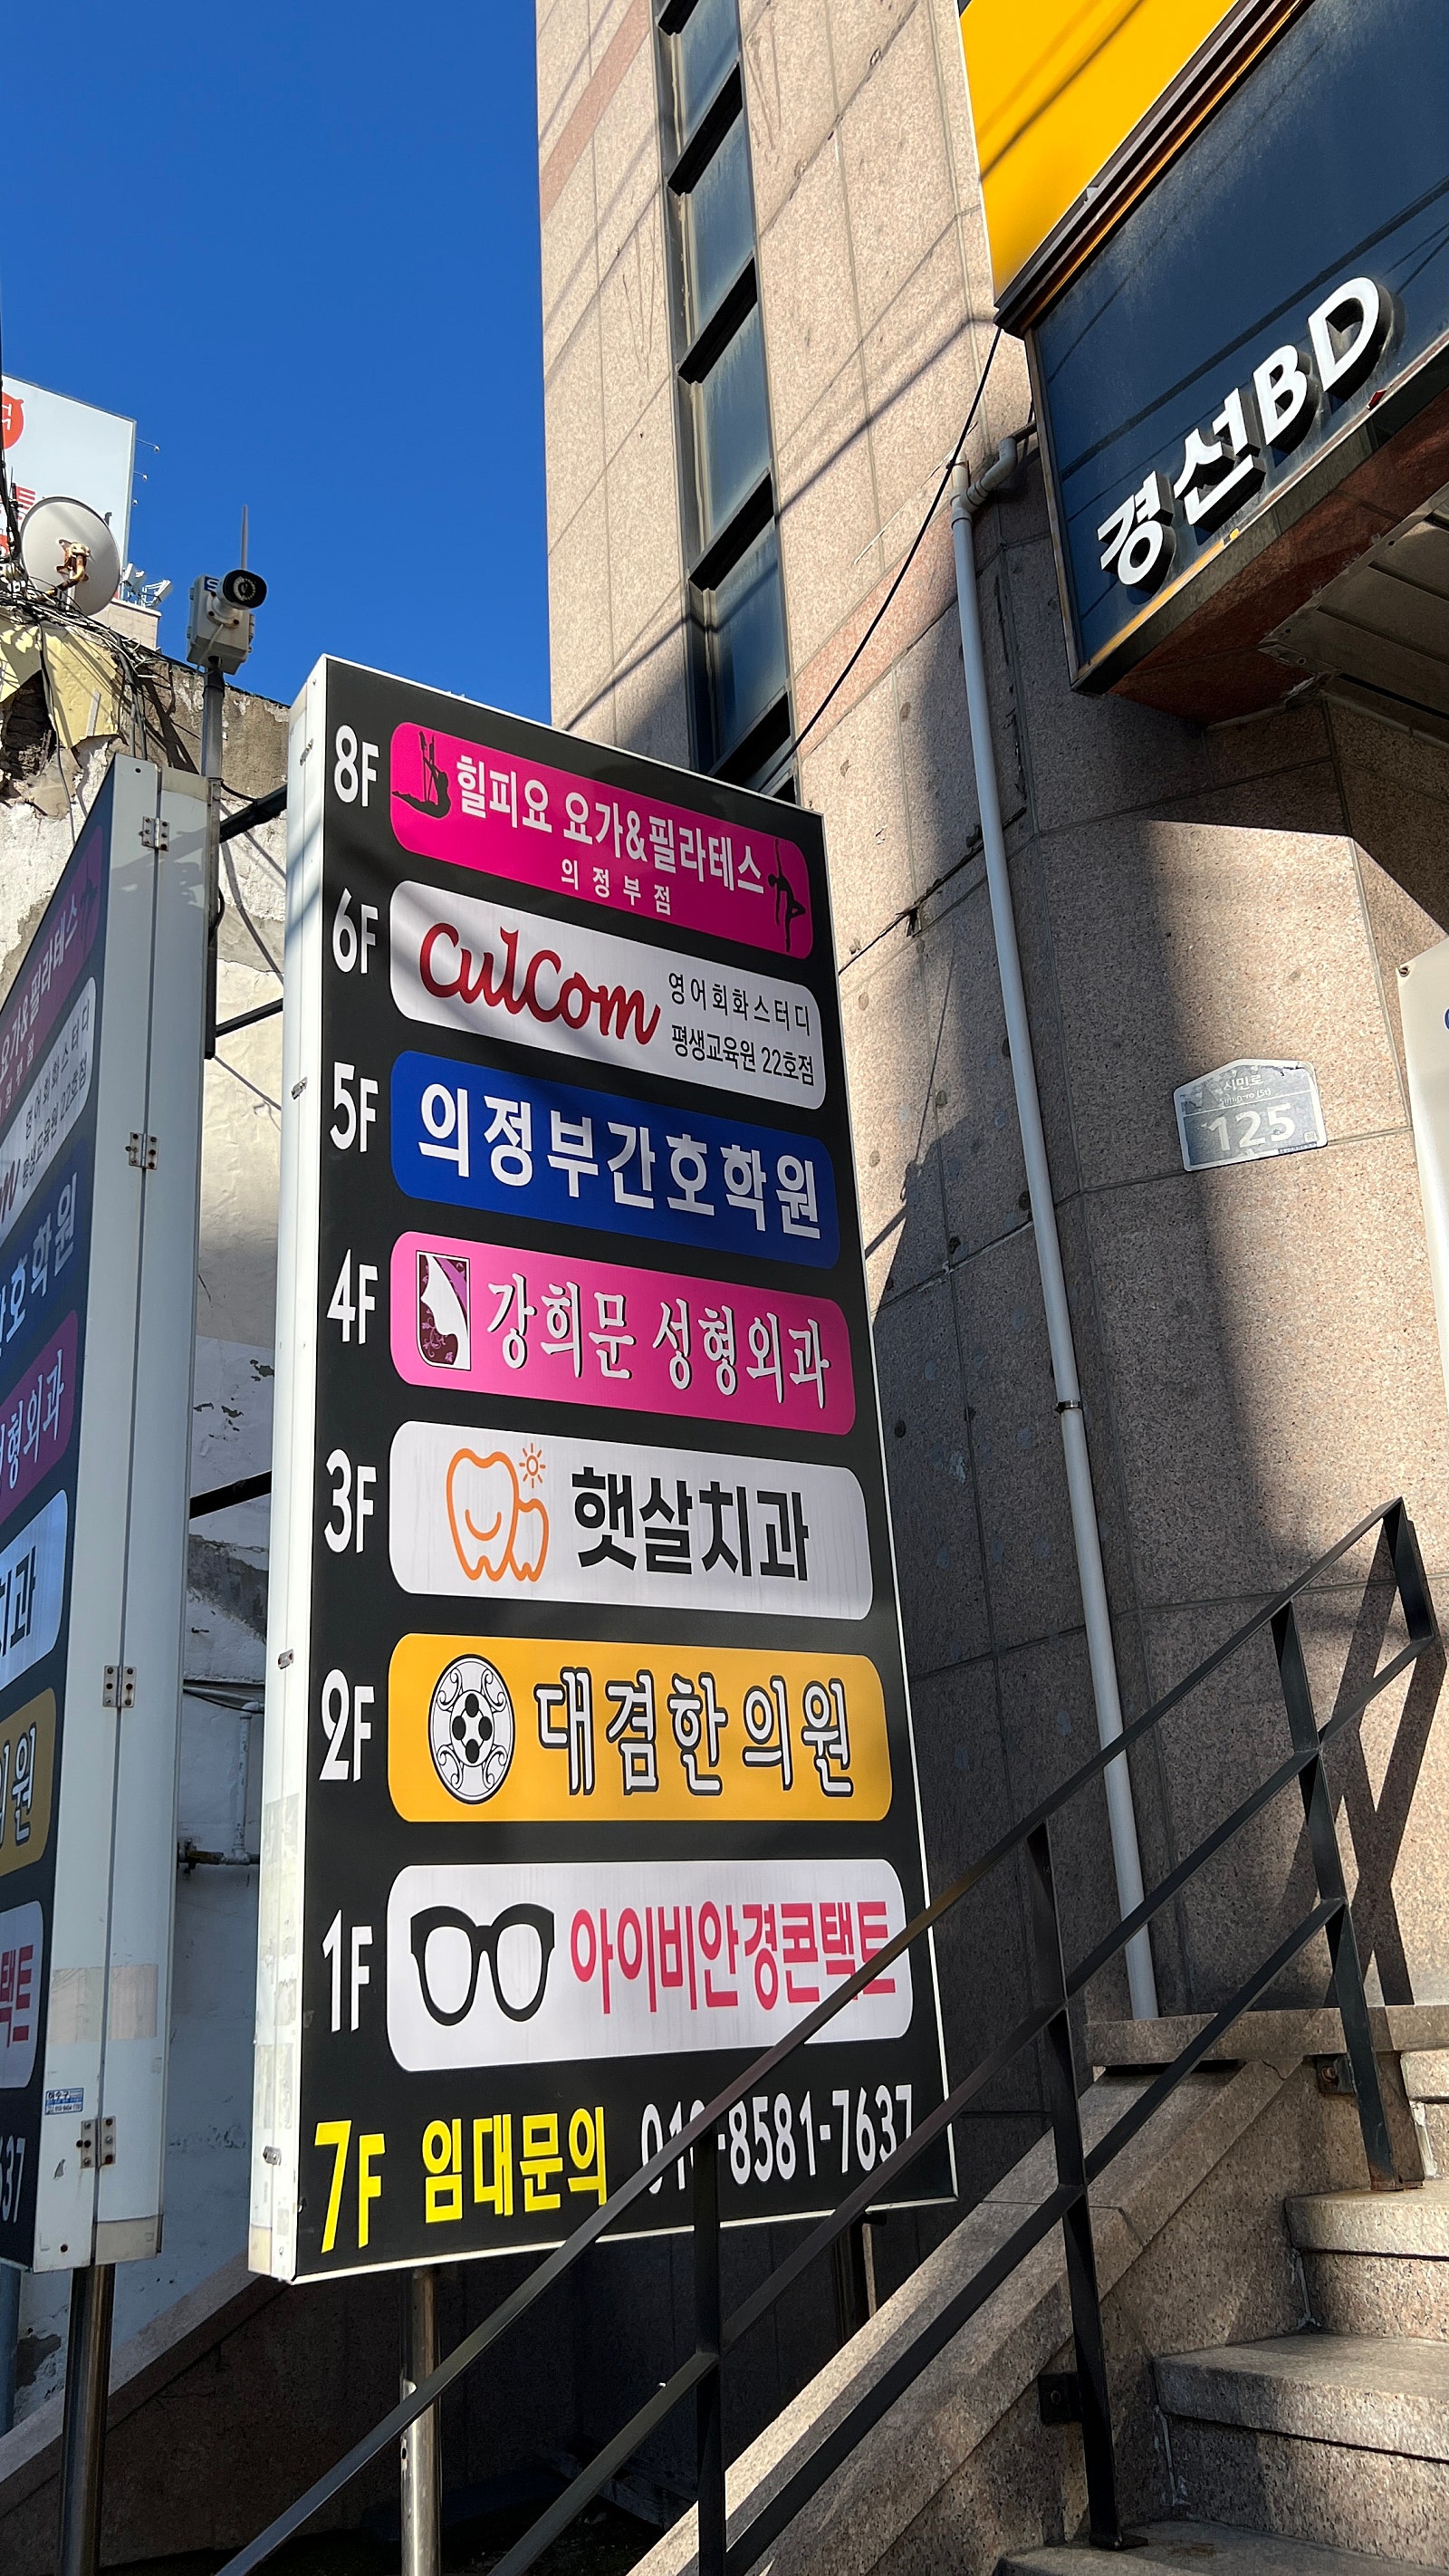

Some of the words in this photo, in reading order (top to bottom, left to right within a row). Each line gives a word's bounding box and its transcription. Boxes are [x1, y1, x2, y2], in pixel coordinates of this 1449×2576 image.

[1097, 276, 1380, 586] 경선BD
[333, 725, 379, 807] 8F
[456, 755, 552, 832] 힐피요
[562, 791, 764, 895] 요가&필라테스
[332, 888, 379, 974] 6F
[419, 922, 661, 1045] CulCom
[330, 1062, 379, 1154] 5F
[672, 1024, 756, 1073] 평생교육원
[761, 1046, 814, 1086] 22호점
[1223, 1074, 1264, 1091] 시민로
[417, 1083, 821, 1240] 의정부간호학원
[1207, 1102, 1296, 1151] 125
[327, 1249, 378, 1344] 4F
[486, 1272, 637, 1380] 강희문
[652, 1298, 830, 1409] 성형외과
[323, 1449, 378, 1553] 3F
[571, 1466, 810, 1582] 햇살치과
[319, 1668, 376, 1783] 2F
[322, 1909, 374, 2033] 1F
[570, 1900, 897, 2015] 아이비안경콘택트
[0, 2136, 26, 2224] 37
[314, 2119, 386, 2254] 7F
[421, 2106, 608, 2225] 임대문의
